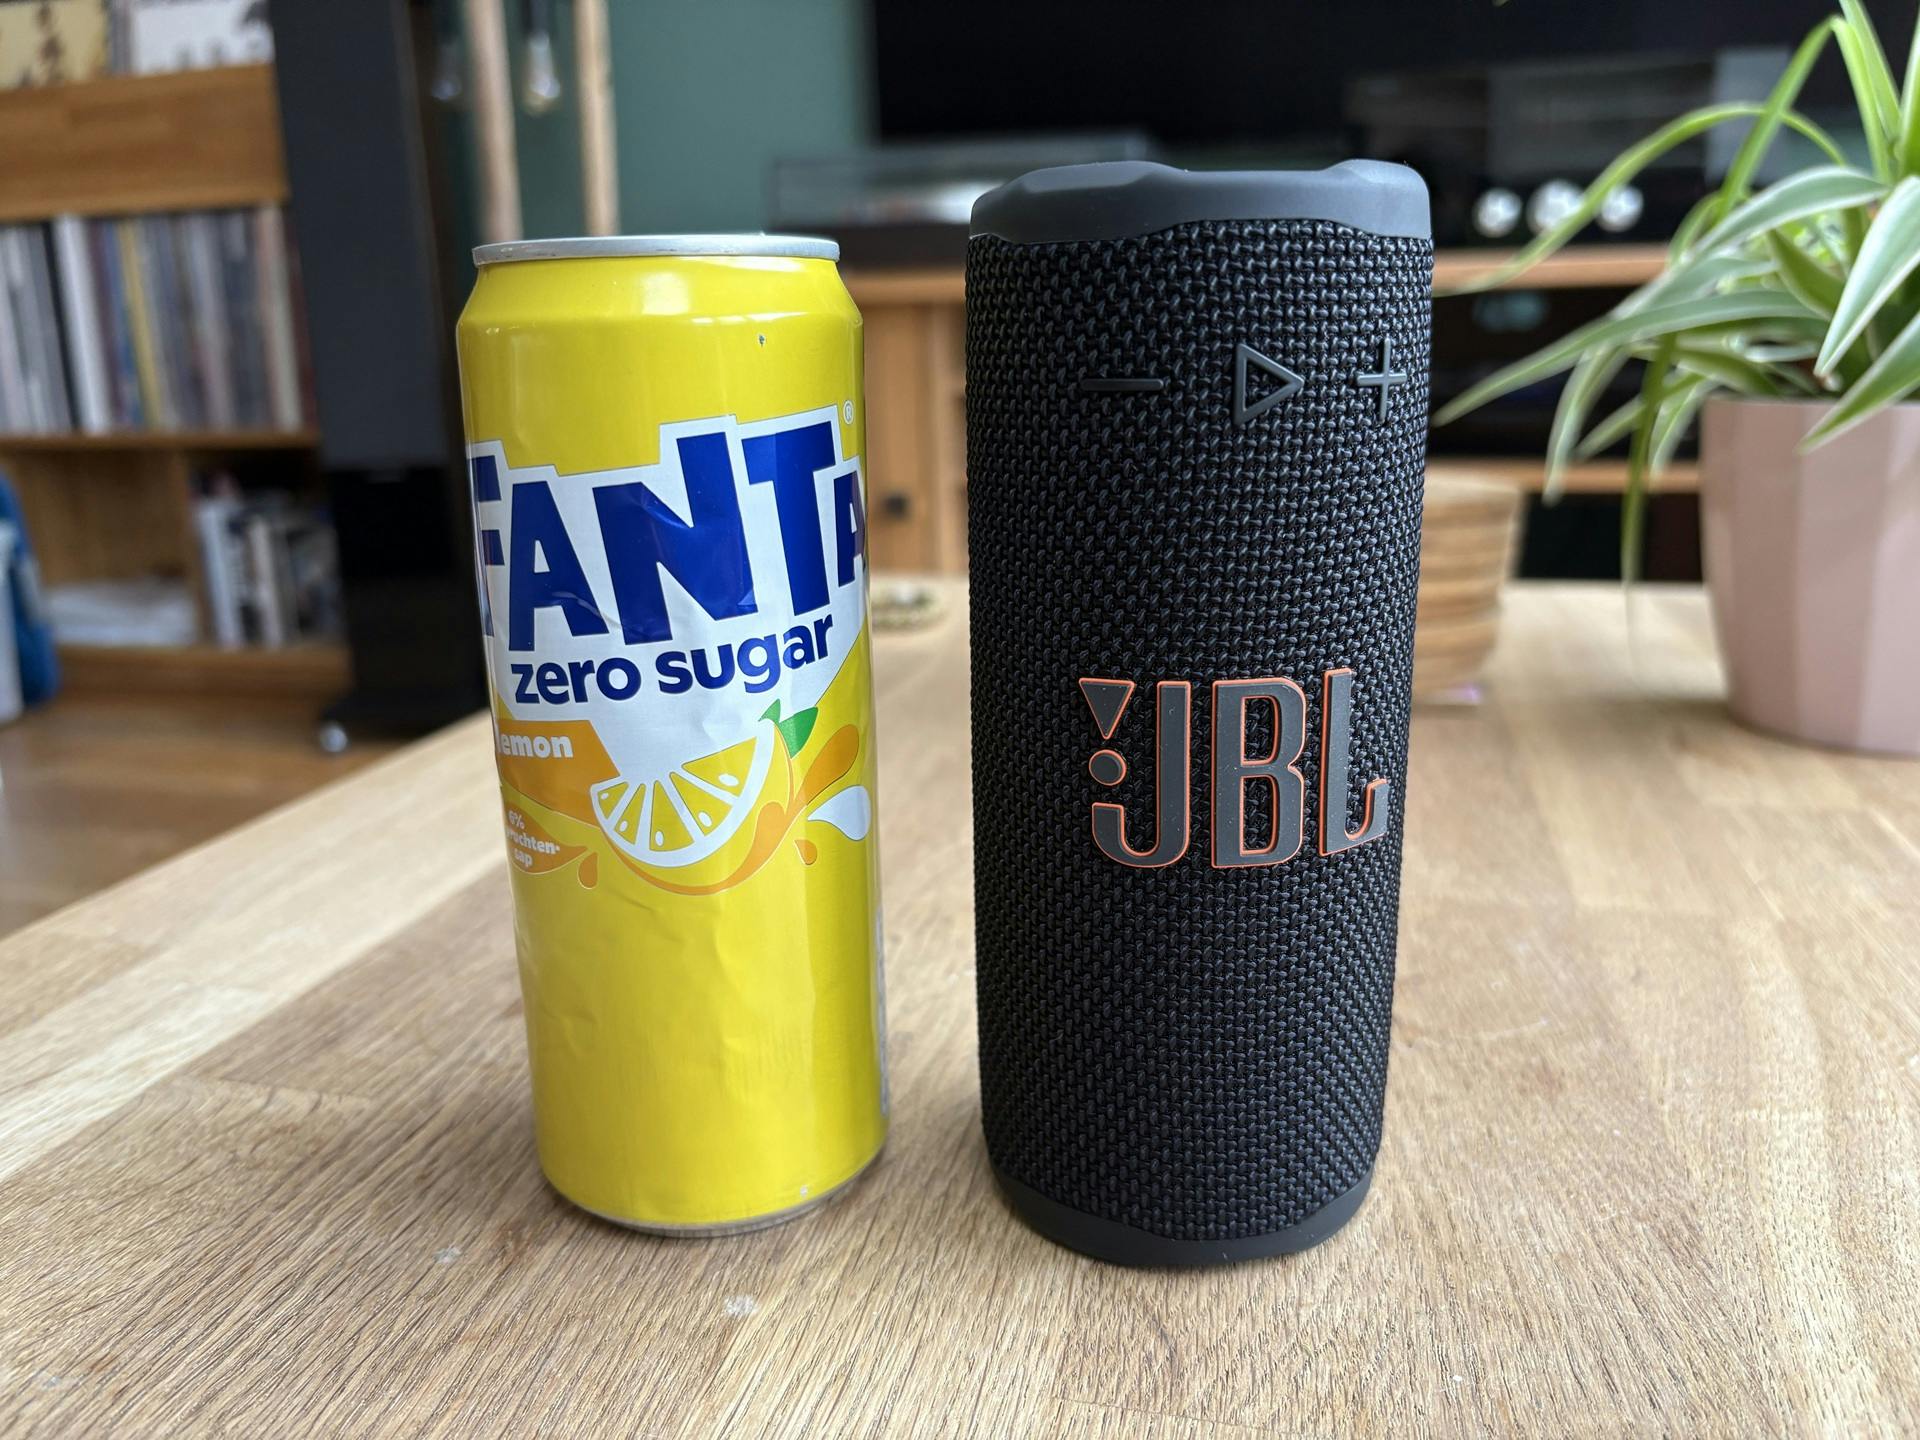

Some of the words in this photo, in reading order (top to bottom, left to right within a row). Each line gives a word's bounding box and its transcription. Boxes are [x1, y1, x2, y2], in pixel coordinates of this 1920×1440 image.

[468, 421, 867, 651] FANTA
[510, 657, 642, 704] zero
[657, 614, 833, 694] sugar
[1090, 668, 1388, 868] JBL
